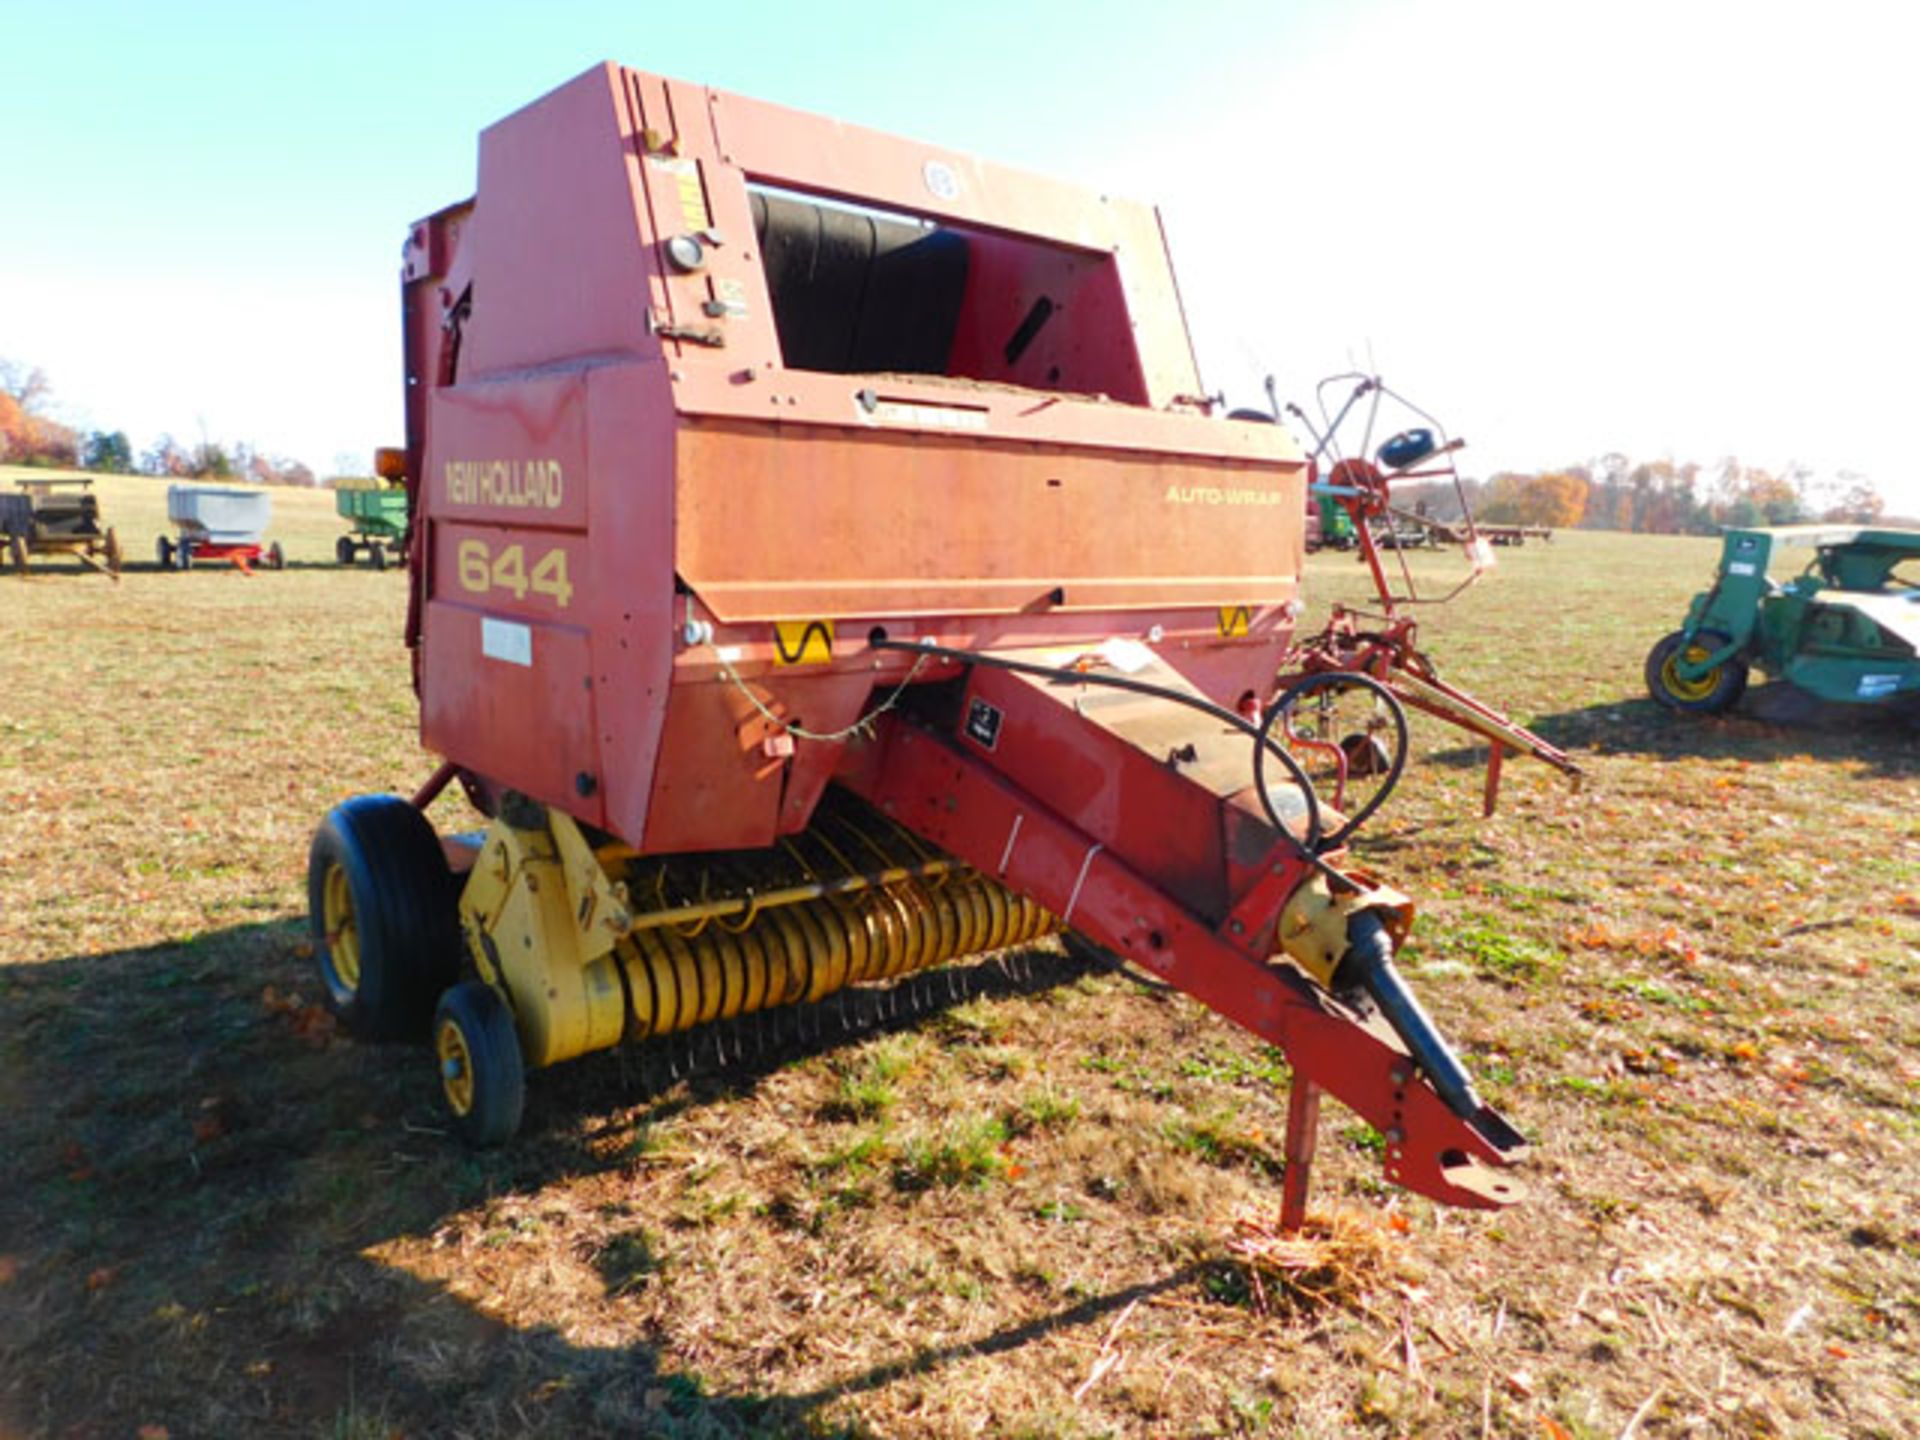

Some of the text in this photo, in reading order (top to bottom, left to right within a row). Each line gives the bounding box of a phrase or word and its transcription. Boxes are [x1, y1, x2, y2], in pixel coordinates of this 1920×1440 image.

[445, 459, 562, 508] NEW HOLLAND
[458, 538, 573, 608] 644
